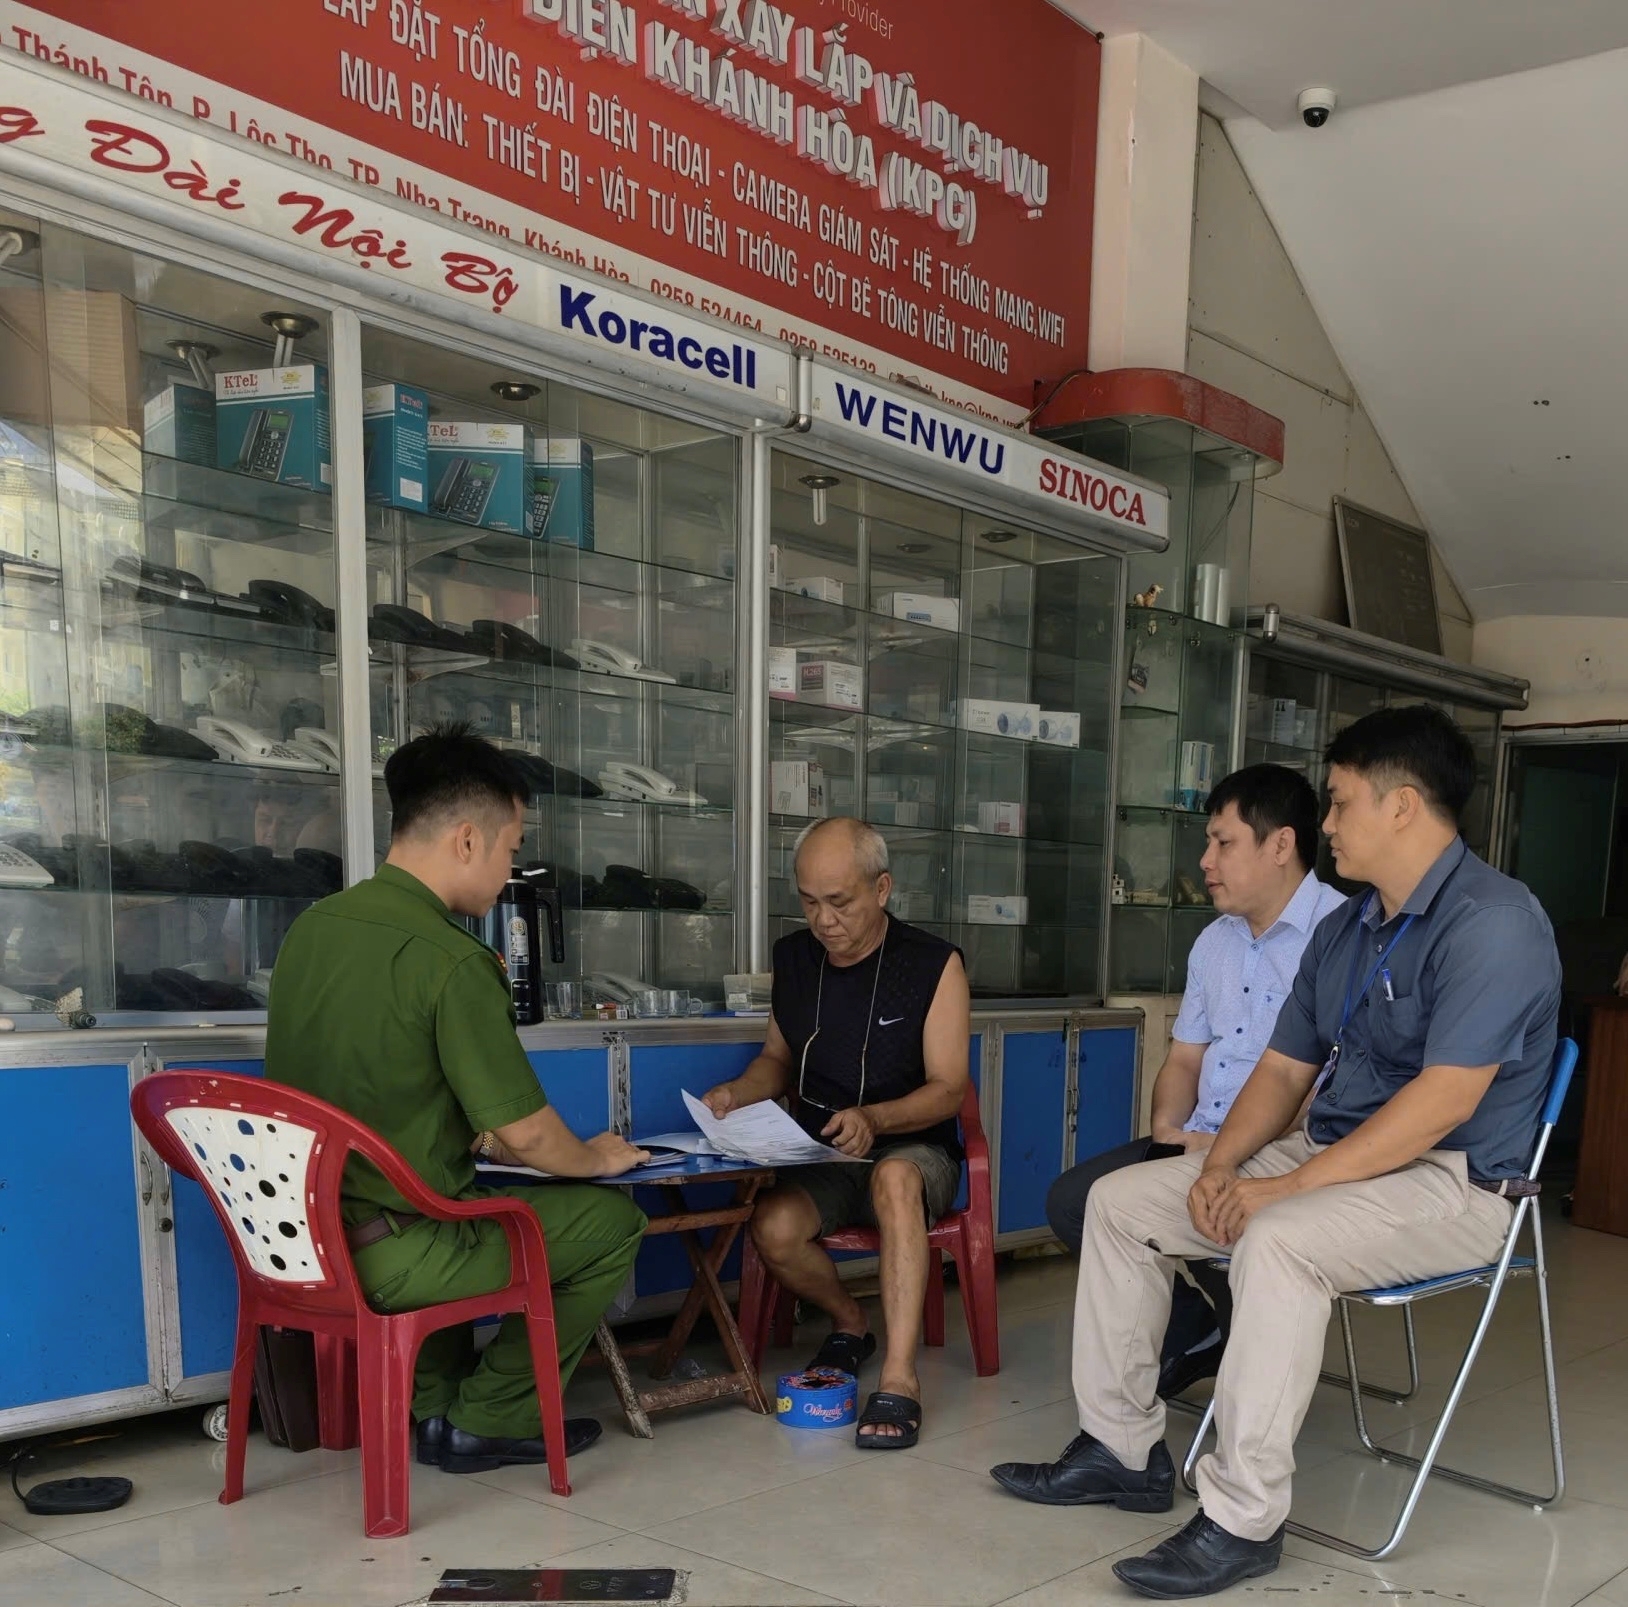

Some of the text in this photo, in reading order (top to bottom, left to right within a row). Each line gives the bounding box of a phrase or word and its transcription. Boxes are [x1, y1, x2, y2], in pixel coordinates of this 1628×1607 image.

[85, 119, 244, 210] Đài
[278, 191, 412, 269] Nội
[441, 252, 519, 314] Bộ
[340, 50, 403, 121] MUA
[411, 82, 469, 148] BÁN:
[482, 113, 551, 183] THIẾT
[560, 148, 580, 205] BỊ
[600, 165, 639, 224] VẬT
[647, 188, 677, 236] TƯ
[682, 198, 727, 259] VIỄN
[735, 231, 798, 288] THÔNG
[813, 259, 846, 310] CỘT
[851, 276, 872, 318] BÊ
[877, 286, 919, 338] TÔNG
[922, 303, 956, 353] VIỄN
[962, 327, 1009, 376] THÔNG
[389, 0, 441, 62] ĐẶT
[453, 18, 521, 99] TỔNG
[535, 64, 574, 124] ĐÀI
[587, 94, 638, 153] ĐIỆN
[648, 120, 710, 189] THOẠI
[733, 161, 811, 233] CAMERA
[818, 205, 862, 256] GIÁM
[870, 227, 899, 272] SÁT
[912, 246, 932, 295] HỆ
[940, 262, 989, 314] THỐNG
[645, 20, 794, 146] KHÁNH
[797, 104, 877, 189] HÒA
[879, 151, 977, 246] (KPC)
[795, 23, 873, 107] LẮP
[873, 72, 922, 141] VÀ
[921, 100, 1002, 184] DỊCH
[1002, 146, 1048, 219] VỤ
[427, 424, 458, 437] TeL
[560, 284, 756, 389] Koracell
[835, 382, 1005, 475] WENWU
[1039, 458, 1147, 526] SINOCA
